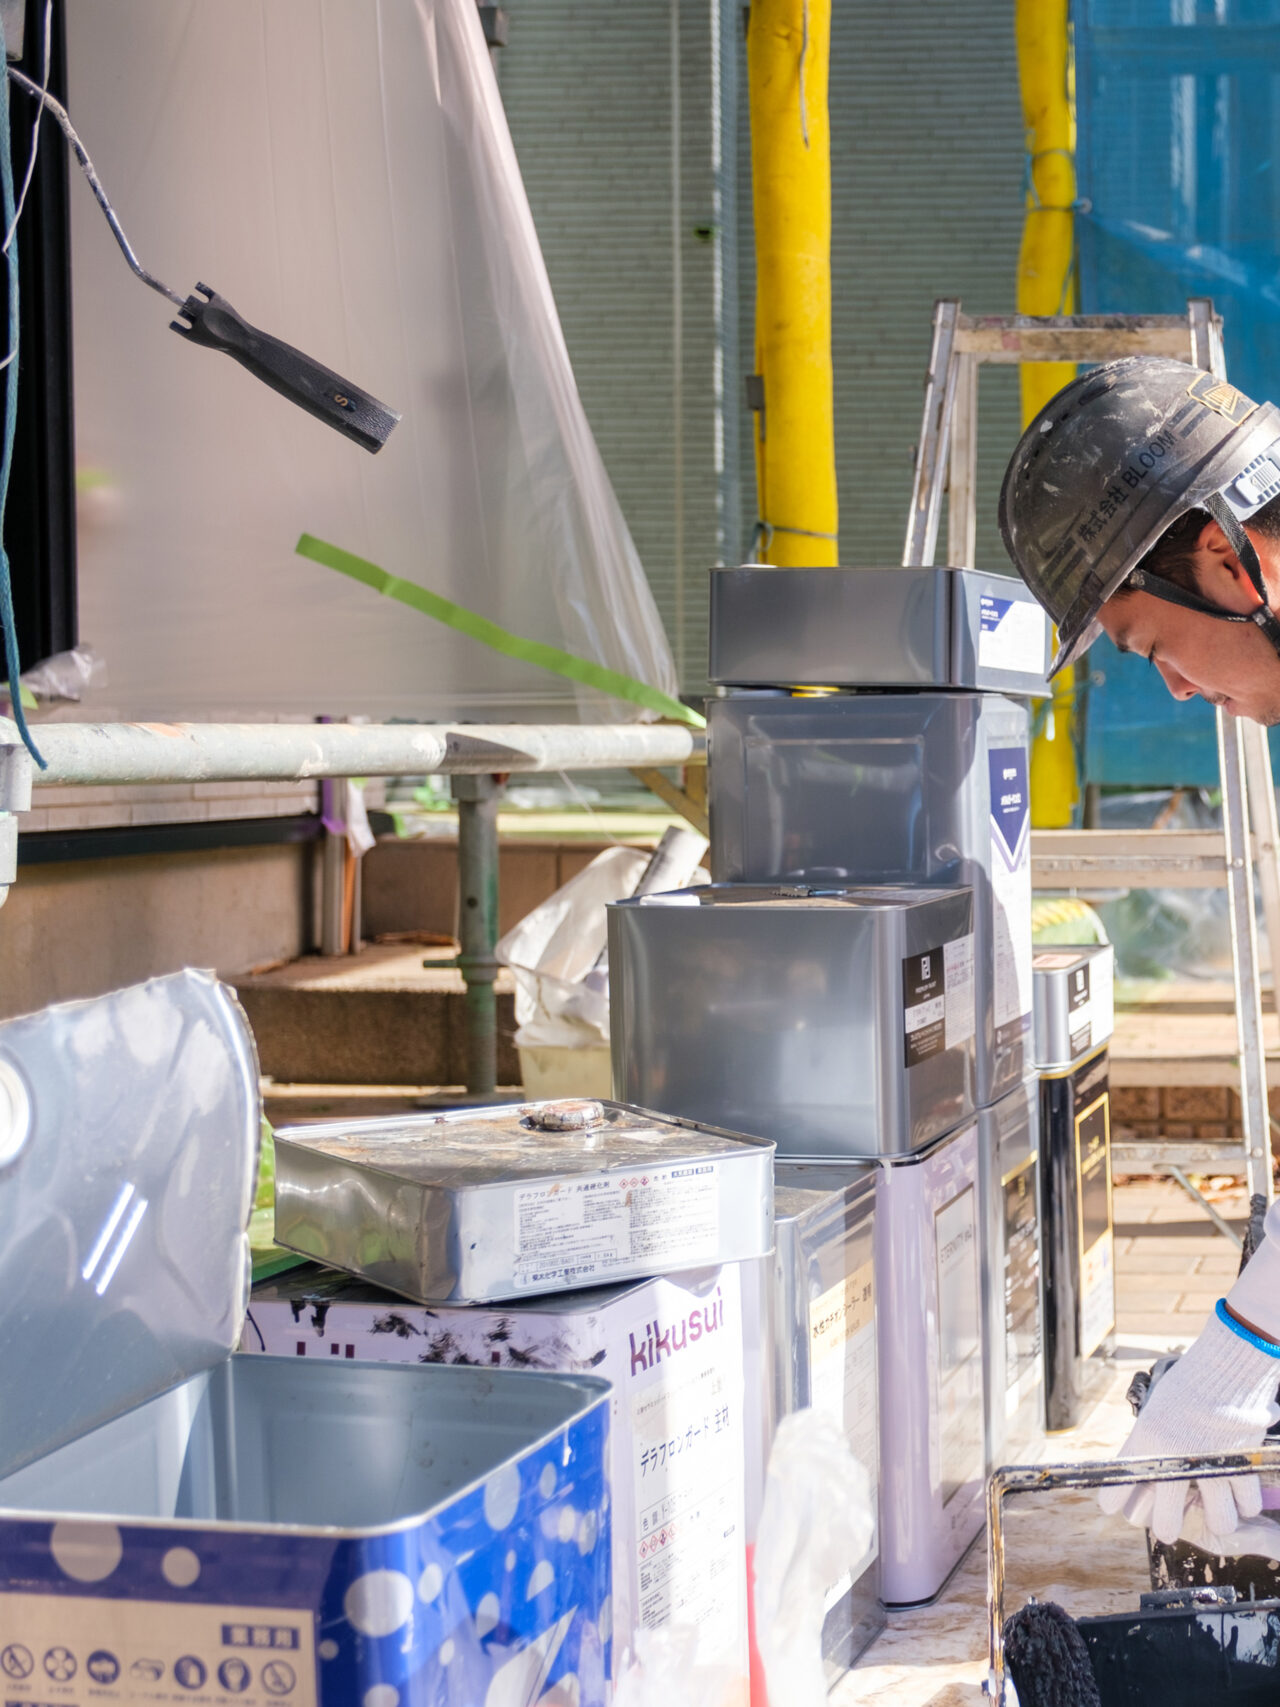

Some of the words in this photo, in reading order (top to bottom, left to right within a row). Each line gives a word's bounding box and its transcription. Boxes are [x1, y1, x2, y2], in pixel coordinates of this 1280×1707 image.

[1077, 486, 1129, 542] 株式会社
[1121, 430, 1178, 489] BLOOM
[629, 1286, 724, 1377] kikusui
